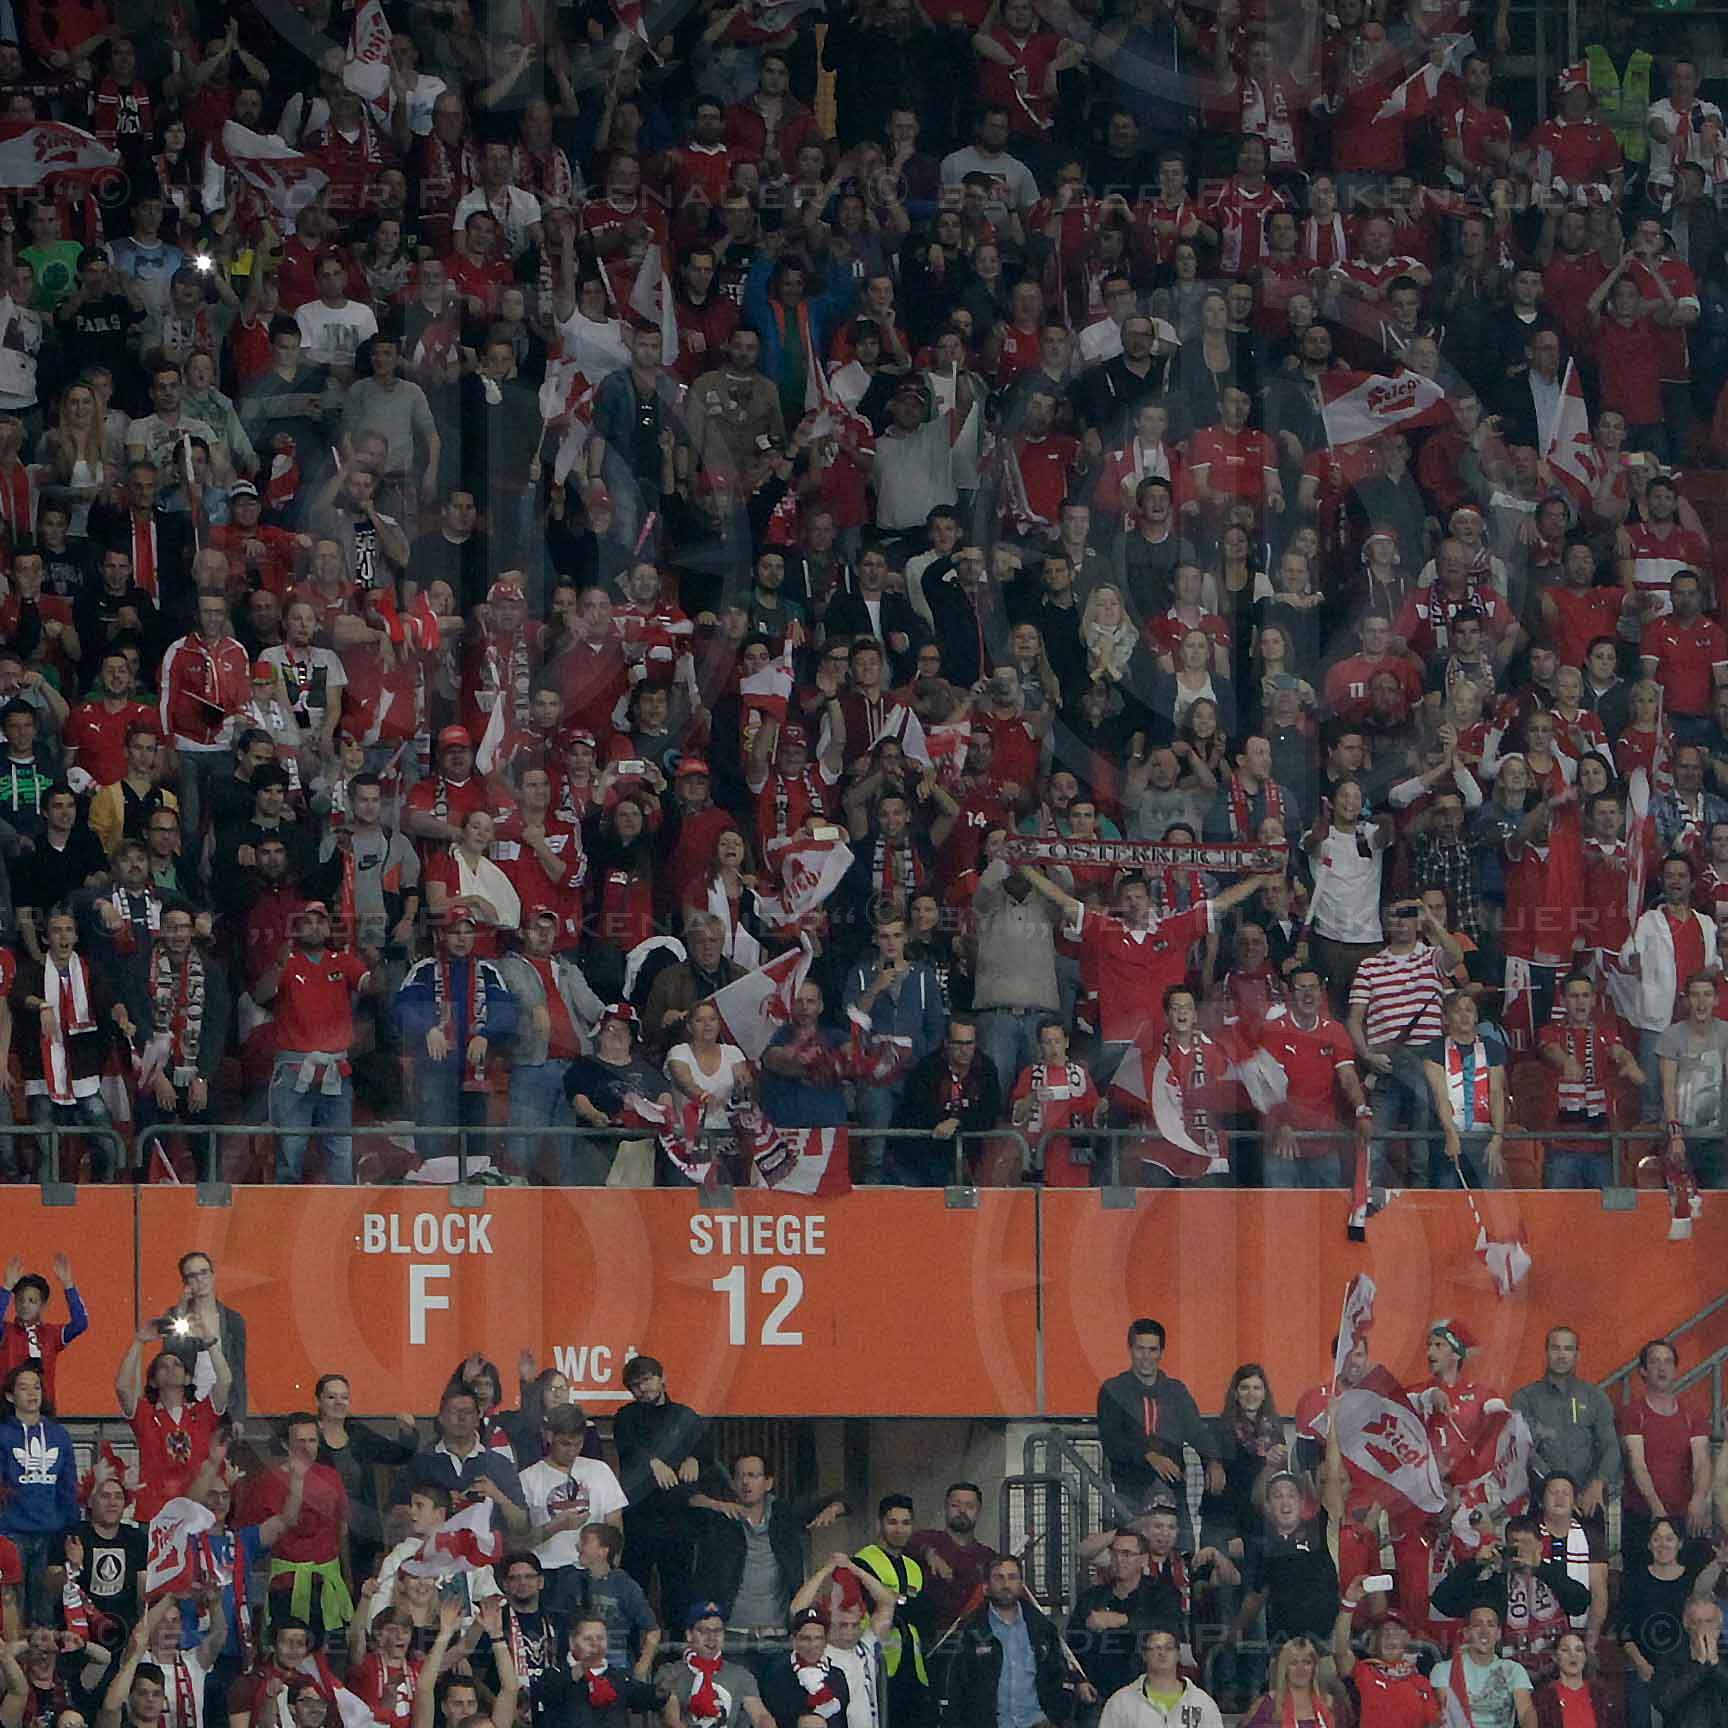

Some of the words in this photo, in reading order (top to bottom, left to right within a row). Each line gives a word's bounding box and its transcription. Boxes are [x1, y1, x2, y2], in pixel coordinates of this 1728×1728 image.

[363, 1213, 493, 1255] BLOCK
[689, 1215, 827, 1255] STIEGE
[409, 1265, 451, 1345] F
[712, 1265, 805, 1346] 12
[554, 1345, 612, 1382] WC
